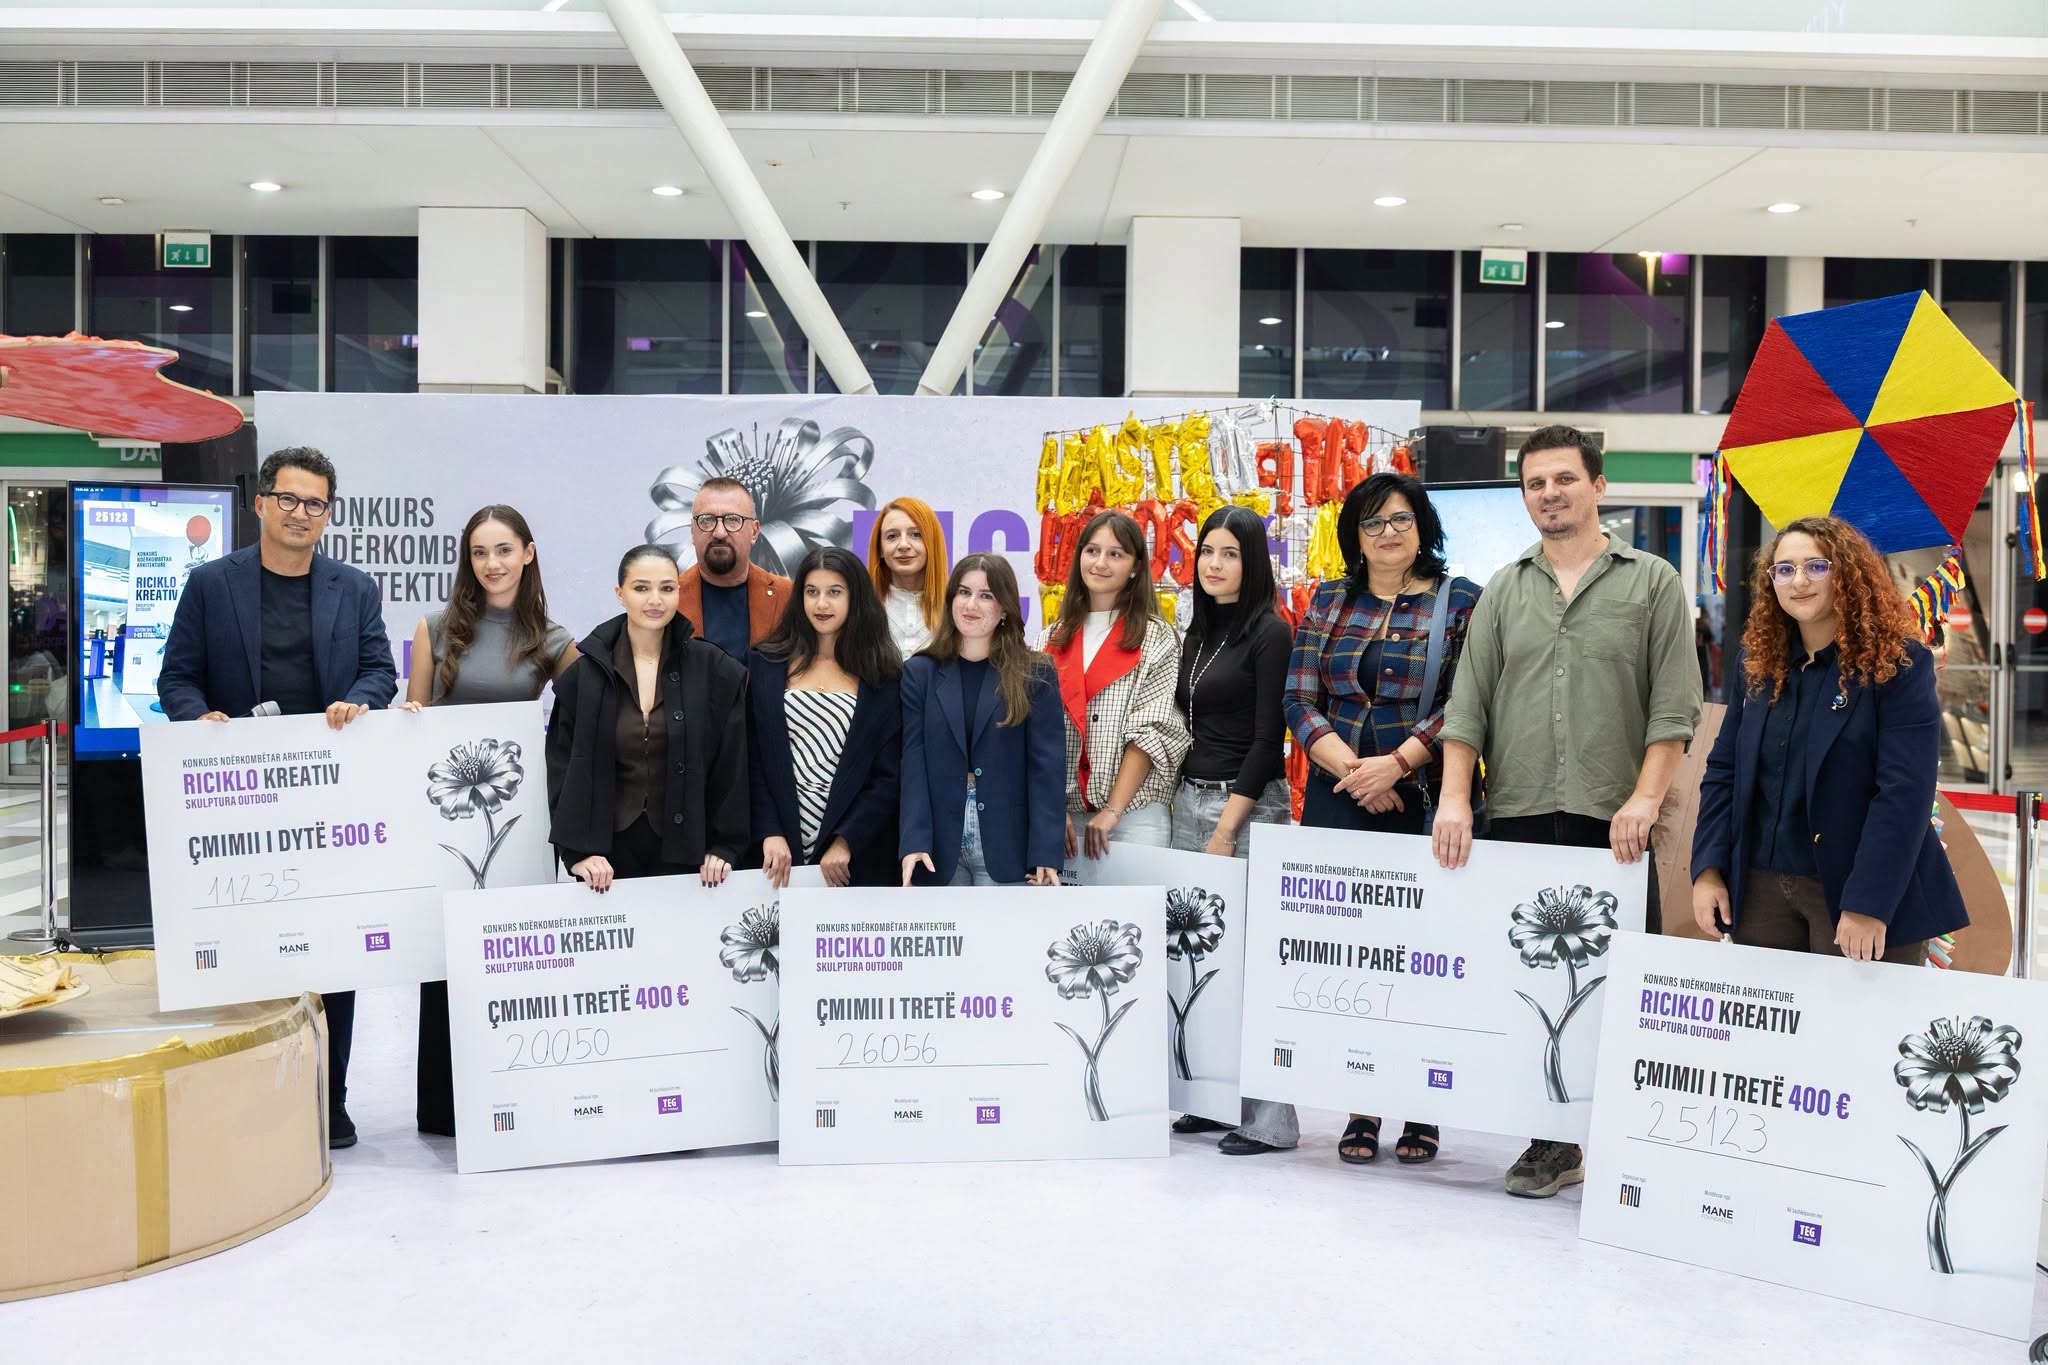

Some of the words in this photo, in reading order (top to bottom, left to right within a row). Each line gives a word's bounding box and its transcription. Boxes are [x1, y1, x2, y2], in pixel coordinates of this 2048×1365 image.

[95, 511, 128, 523] 25123
[327, 496, 434, 527] ONKURS
[315, 528, 464, 565] NDËRKOMB
[136, 576, 177, 589] RICIKLO
[135, 589, 178, 601] KREATIV
[183, 757, 218, 768] KONKURS
[220, 752, 280, 766] NDËRKOMBËTAR
[282, 750, 332, 762] ARKITEKTURE
[184, 768, 258, 795] RICIKLO
[264, 763, 340, 789] KREATIV
[185, 796, 237, 809] SKULPTURA
[238, 793, 278, 805] OUTDOOR
[278, 821, 327, 852] DYTË
[332, 822, 370, 848] 500
[374, 821, 387, 844] €
[1282, 861, 1313, 874] KONKURS
[1314, 864, 1369, 878] NDËRKOMBËTAR
[1370, 870, 1417, 882] ARKITEKTURE
[208, 868, 301, 904] 11235
[1281, 875, 1347, 903] RICIKLO
[1351, 882, 1424, 910] KREATIV
[1280, 901, 1325, 915] SKULPTURA
[1326, 905, 1363, 919] OUTDOOR
[483, 923, 517, 934] KONKURS
[519, 917, 577, 932] NDËRKOMBËTAR
[579, 914, 627, 928] ARKITEKTURE
[816, 923, 849, 933] KONKURS
[851, 921, 908, 932] NDËRKOMBËTAR
[909, 922, 956, 931] ARKITEKTURE
[279, 943, 310, 954] MANE
[370, 935, 385, 945] TEG
[483, 933, 555, 960] RICIKLO
[560, 927, 635, 954] KREATIV
[816, 937, 885, 958] RICIKLO
[890, 936, 963, 957] KREATIV
[485, 961, 534, 974] SKULPTURA
[536, 957, 575, 970] OUTDOOR
[816, 962, 864, 972] SKULPTURA
[865, 961, 903, 971] OUTDOOR
[1358, 945, 1406, 973] PARË
[1410, 951, 1448, 978] 800
[1452, 956, 1466, 979] €
[1293, 972, 1394, 1017] 66667
[1643, 973, 1678, 988] KONKURS
[1679, 978, 1741, 996] NDËRKOMBËTAR
[1742, 987, 1794, 1003] ARKITEKTURE
[573, 984, 631, 1015] TRETË
[635, 986, 673, 1010] 400
[677, 984, 689, 1007] €
[900, 992, 956, 1019] TRETË
[960, 996, 997, 1019] 400
[1001, 996, 1014, 1018] €
[1640, 989, 1714, 1023] RICIKLO
[1718, 1000, 1801, 1035] KREATIV
[1639, 1017, 1688, 1036] SKULPTURA
[1690, 1025, 1731, 1042] OUTDOOR
[507, 1028, 610, 1069] 20050
[838, 1032, 937, 1066] 26056
[1346, 1060, 1375, 1072] MANE
[1433, 1072, 1447, 1083] TEG
[663, 1098, 677, 1108] TEG
[1722, 1073, 1785, 1109] TRETË
[1788, 1084, 1831, 1116] 400
[1836, 1093, 1851, 1120] €
[574, 1106, 604, 1117] MANE
[894, 1110, 923, 1119] MANE
[981, 1109, 995, 1118] TEG
[1647, 1100, 1768, 1153] 25123
[1702, 1204, 1734, 1219] MANE
[1800, 1225, 1816, 1237] TEG
